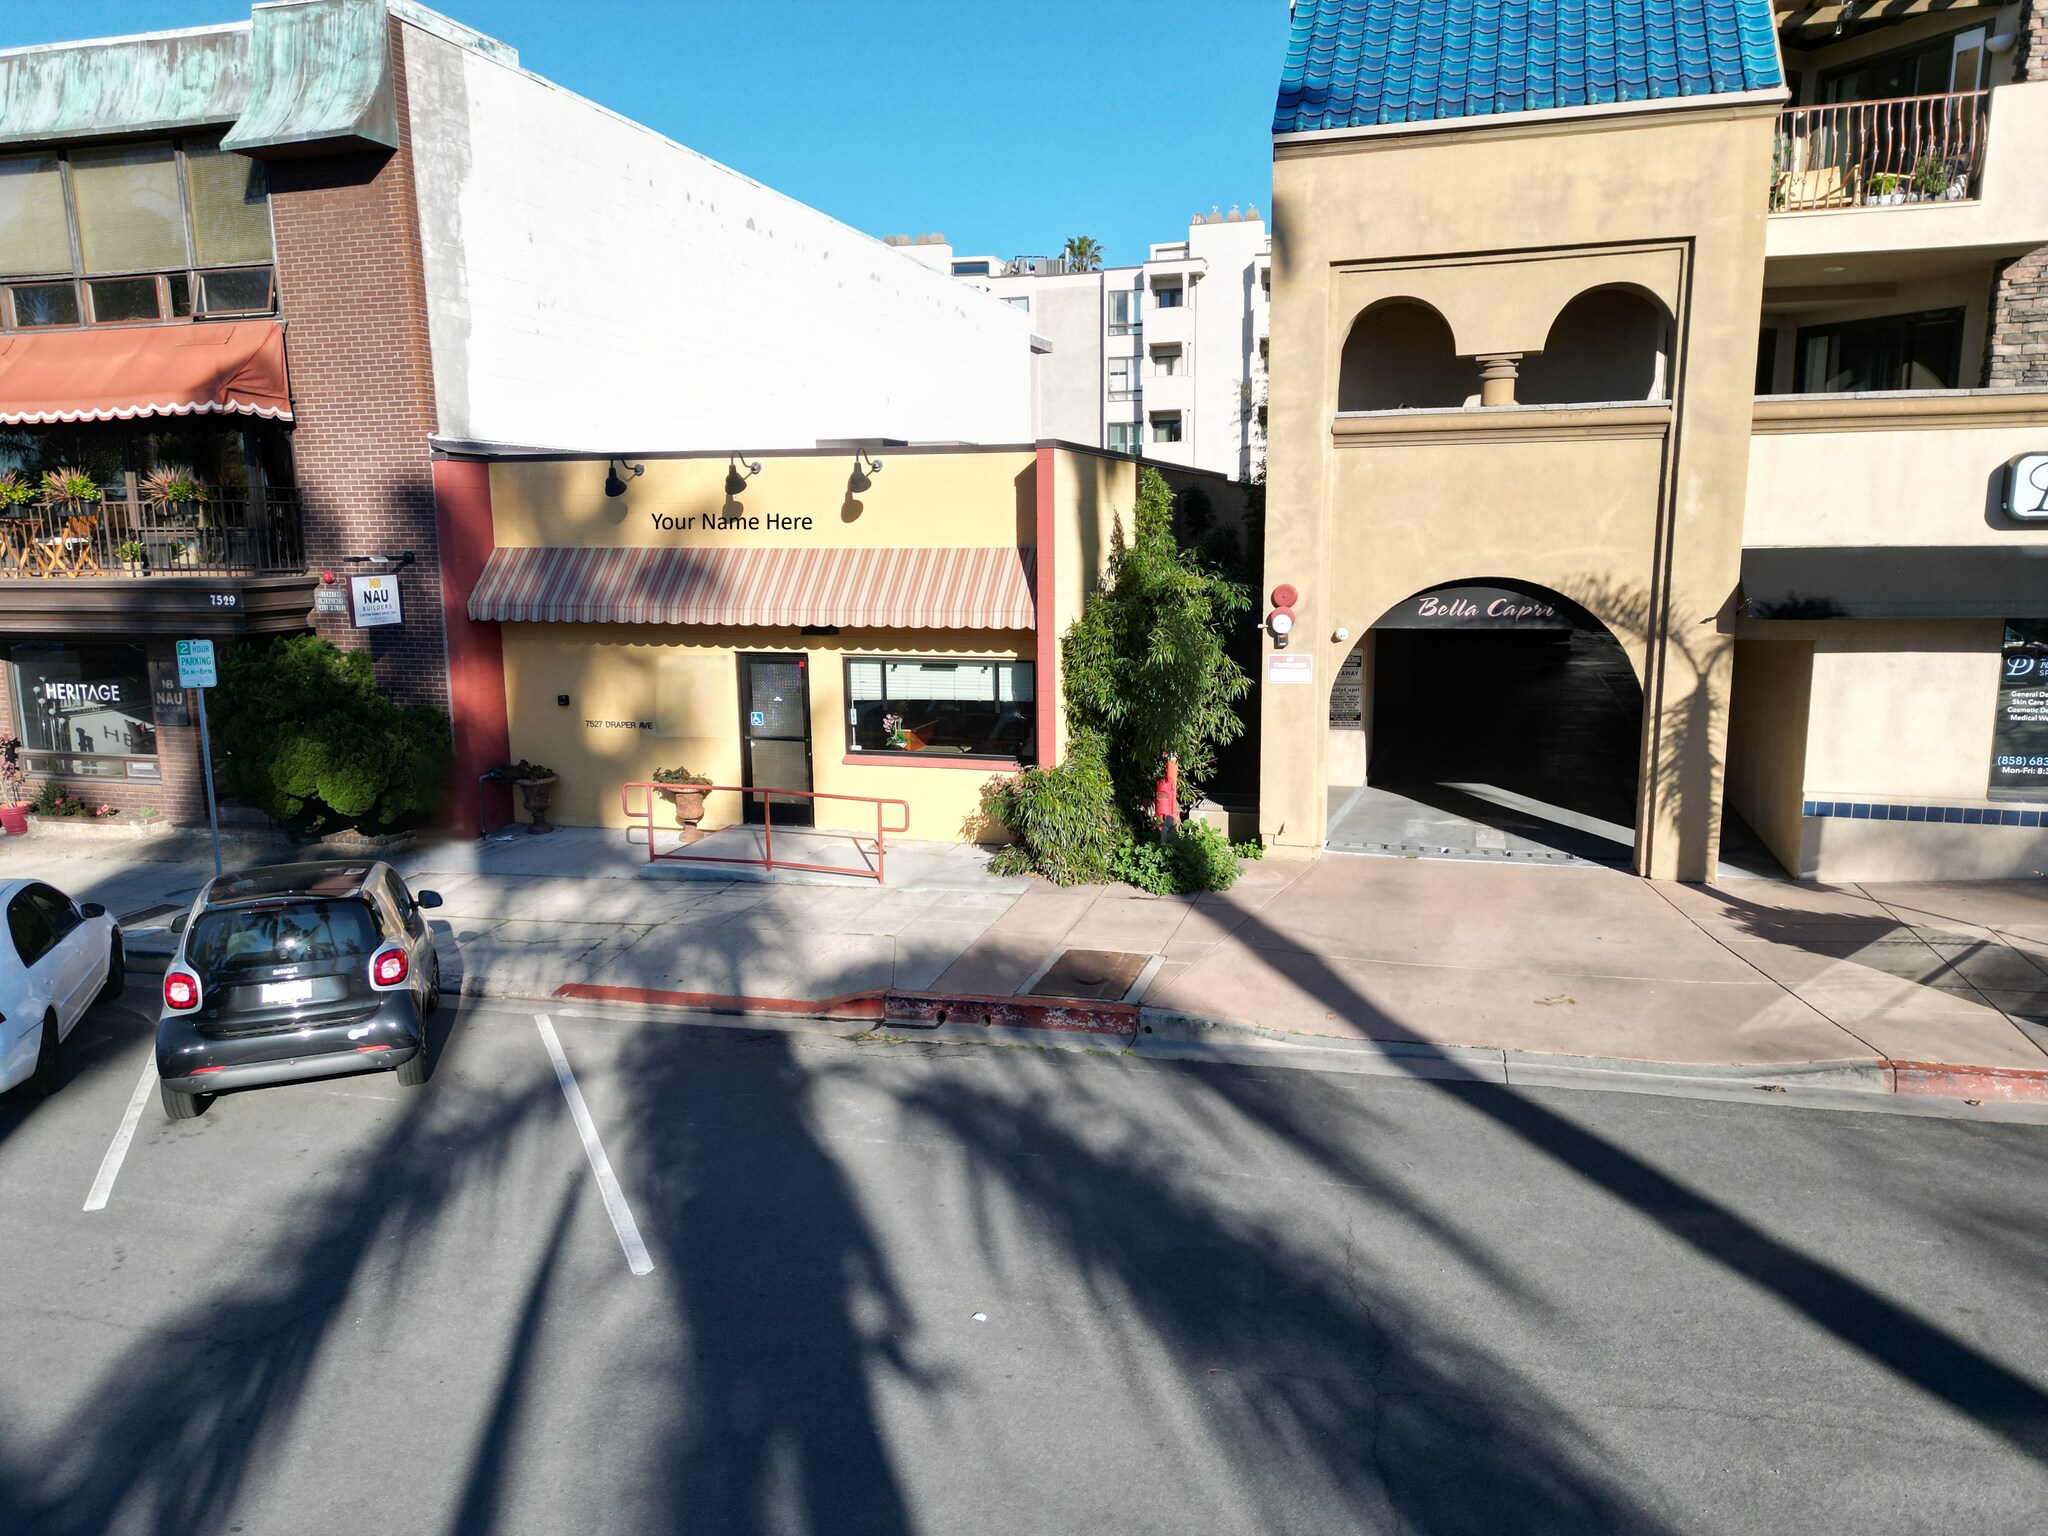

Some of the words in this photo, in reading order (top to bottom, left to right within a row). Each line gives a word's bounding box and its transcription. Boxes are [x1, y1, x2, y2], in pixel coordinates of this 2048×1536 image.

[210, 594, 236, 606] 7529
[363, 589, 389, 604] NAU
[362, 603, 393, 612] BUILDERS
[1418, 596, 1480, 617] Bella
[1487, 598, 1556, 622] Capri
[180, 643, 189, 654] 2
[192, 645, 210, 653] HOUR
[181, 656, 212, 667] PARKING
[45, 683, 120, 701] HERITAGE
[156, 692, 183, 705] NAU
[585, 720, 603, 728] 7527
[605, 720, 637, 729] DRAPER
[639, 721, 653, 729] AVE
[1997, 756, 2027, 767] (858)
[2029, 756, 2048, 766] 683
[2002, 766, 2036, 774] Mon-Fri:
